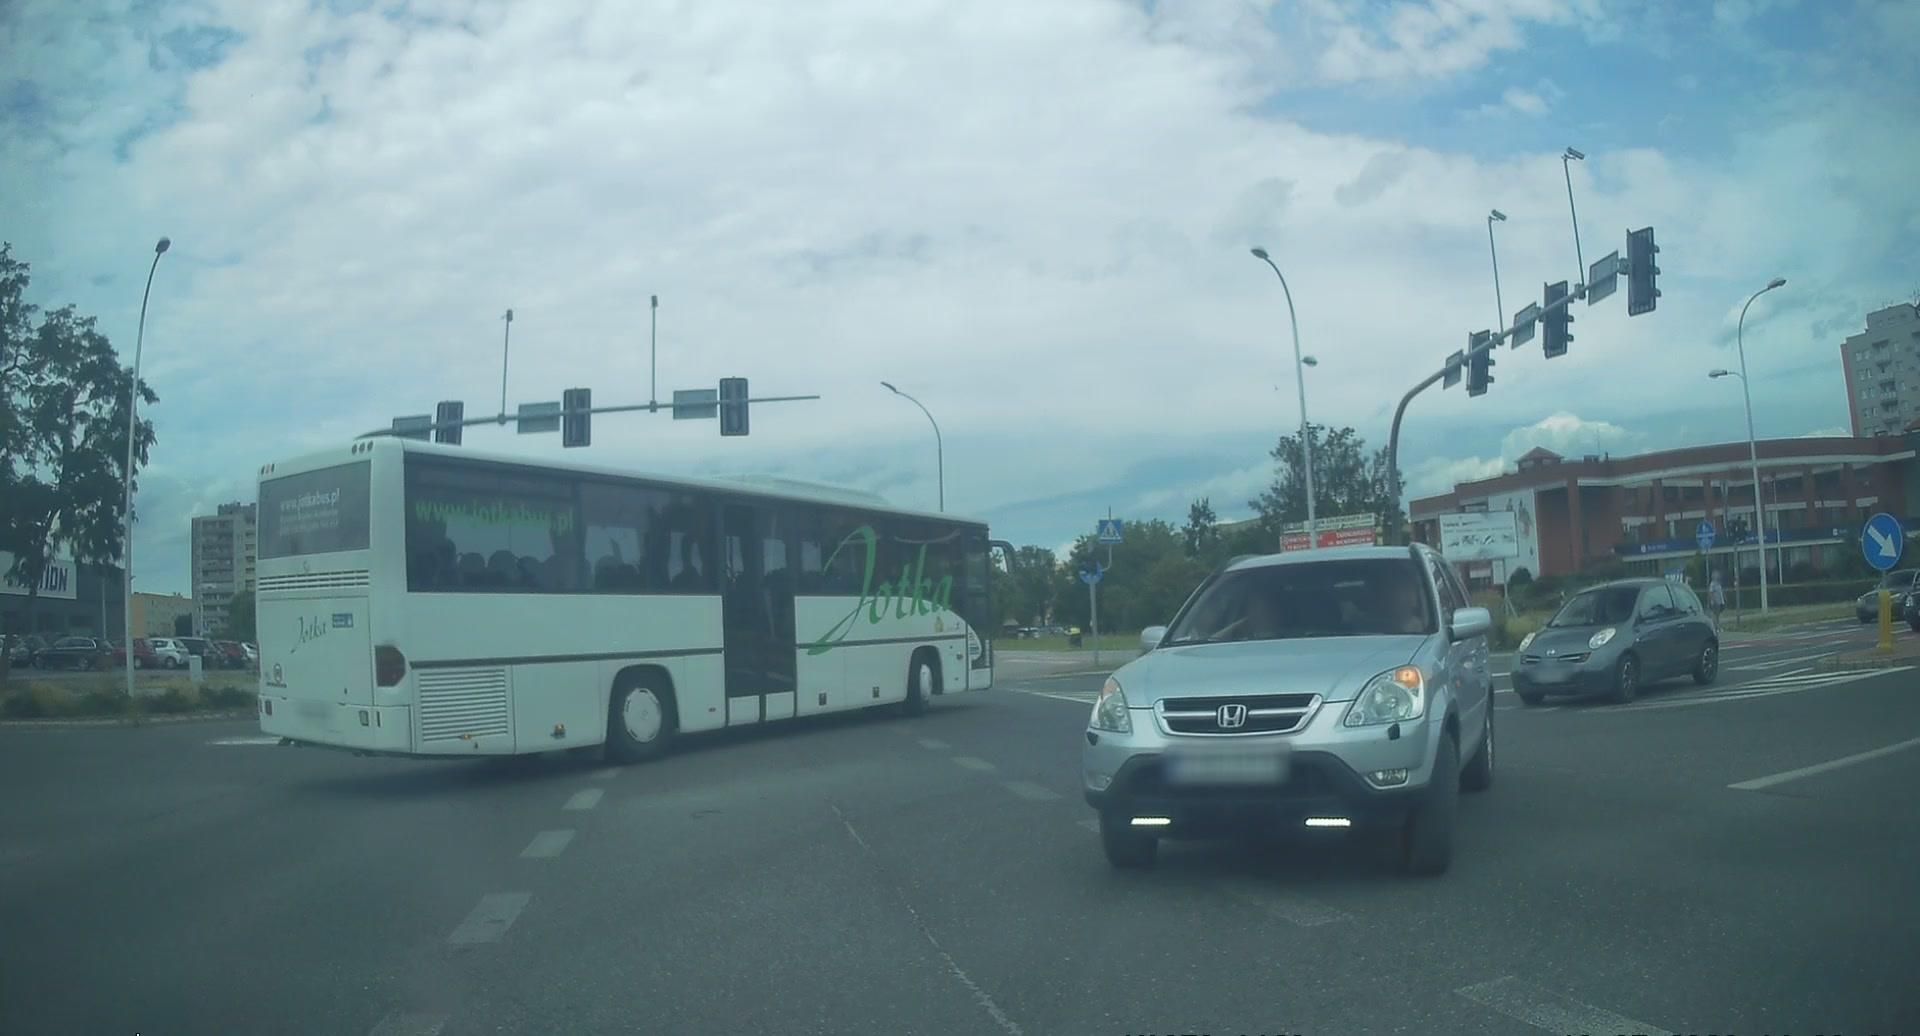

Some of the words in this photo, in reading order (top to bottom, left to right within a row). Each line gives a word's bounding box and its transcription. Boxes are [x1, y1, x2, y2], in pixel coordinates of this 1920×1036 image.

[280, 487, 340, 511] www.jotkabus.pl
[415, 499, 574, 536] www.jotkabus.pl
[807, 525, 953, 655] Jotka
[290, 616, 326, 653] Jotka
